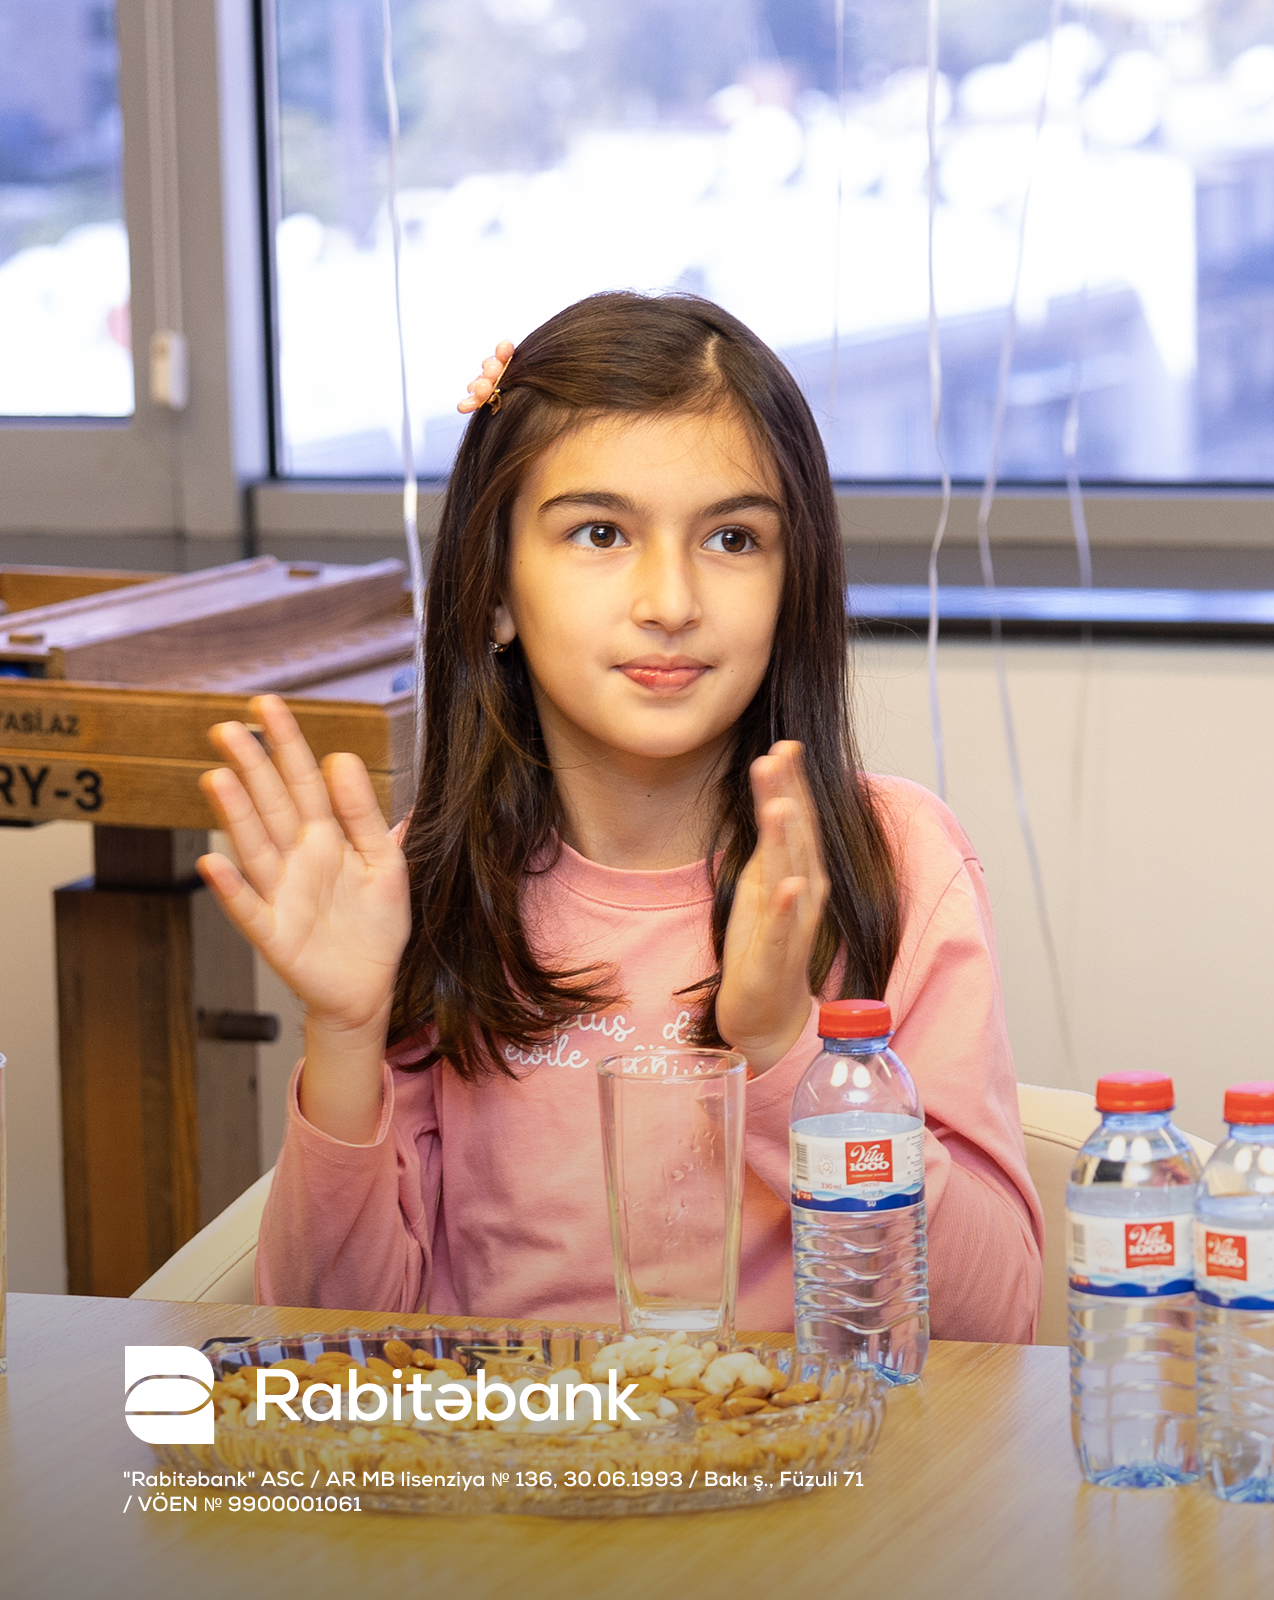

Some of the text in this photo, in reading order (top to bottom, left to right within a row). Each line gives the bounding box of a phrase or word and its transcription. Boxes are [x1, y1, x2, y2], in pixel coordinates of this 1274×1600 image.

[850, 1144, 886, 1163] Vita
[849, 1160, 890, 1172] 1000
[1128, 1225, 1167, 1245] Vita
[1128, 1243, 1173, 1256] 1000
